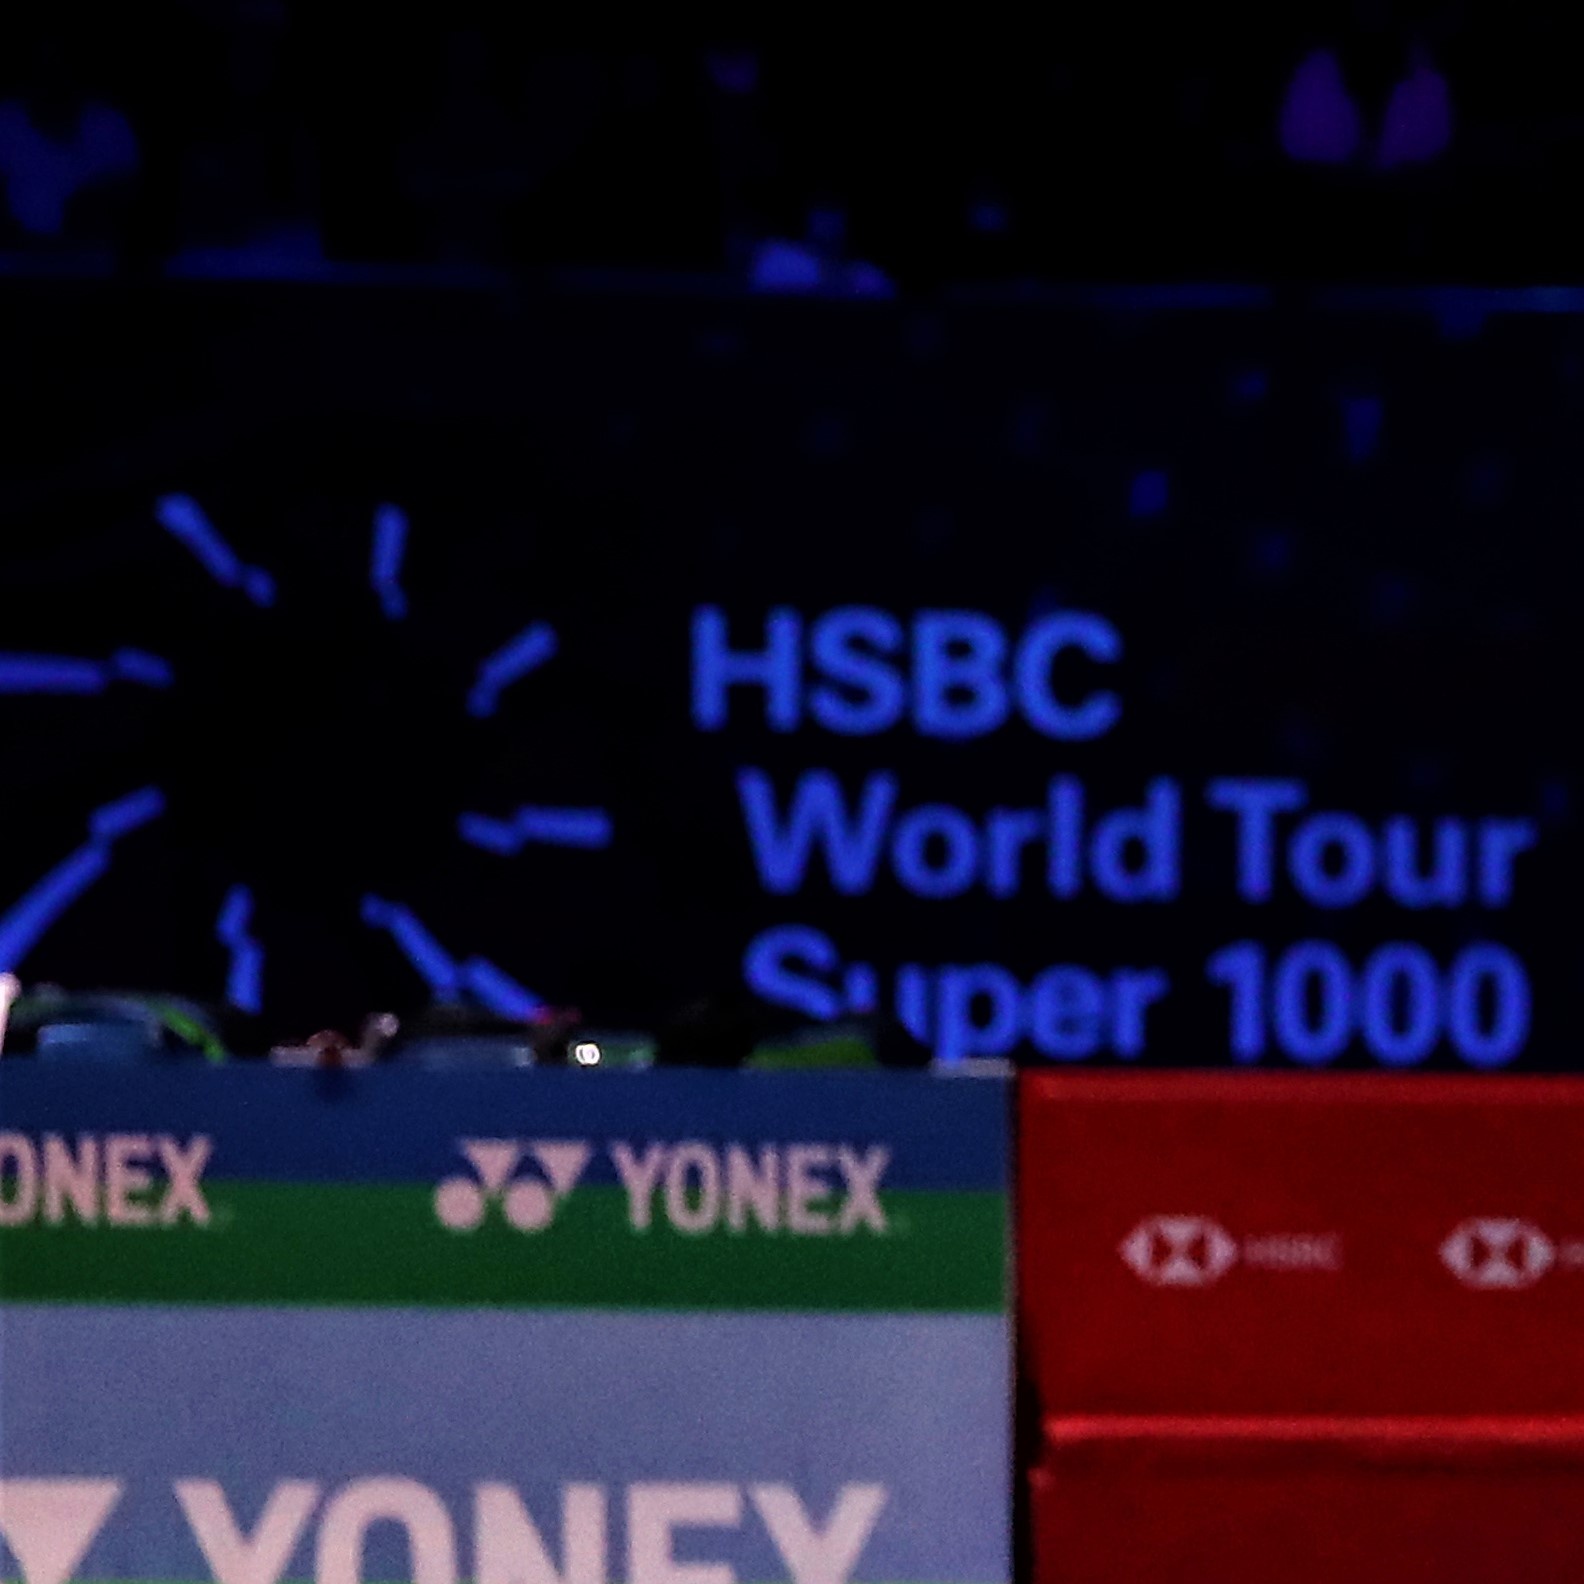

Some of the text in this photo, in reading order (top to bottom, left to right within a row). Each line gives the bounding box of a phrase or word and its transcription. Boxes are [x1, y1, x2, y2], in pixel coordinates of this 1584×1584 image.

[691, 604, 1120, 738] HSBC
[738, 766, 1535, 906] World Tour
[741, 922, 1533, 1067] Super 1000
[0, 1129, 214, 1228] ONEX
[610, 1142, 891, 1235] YONEX
